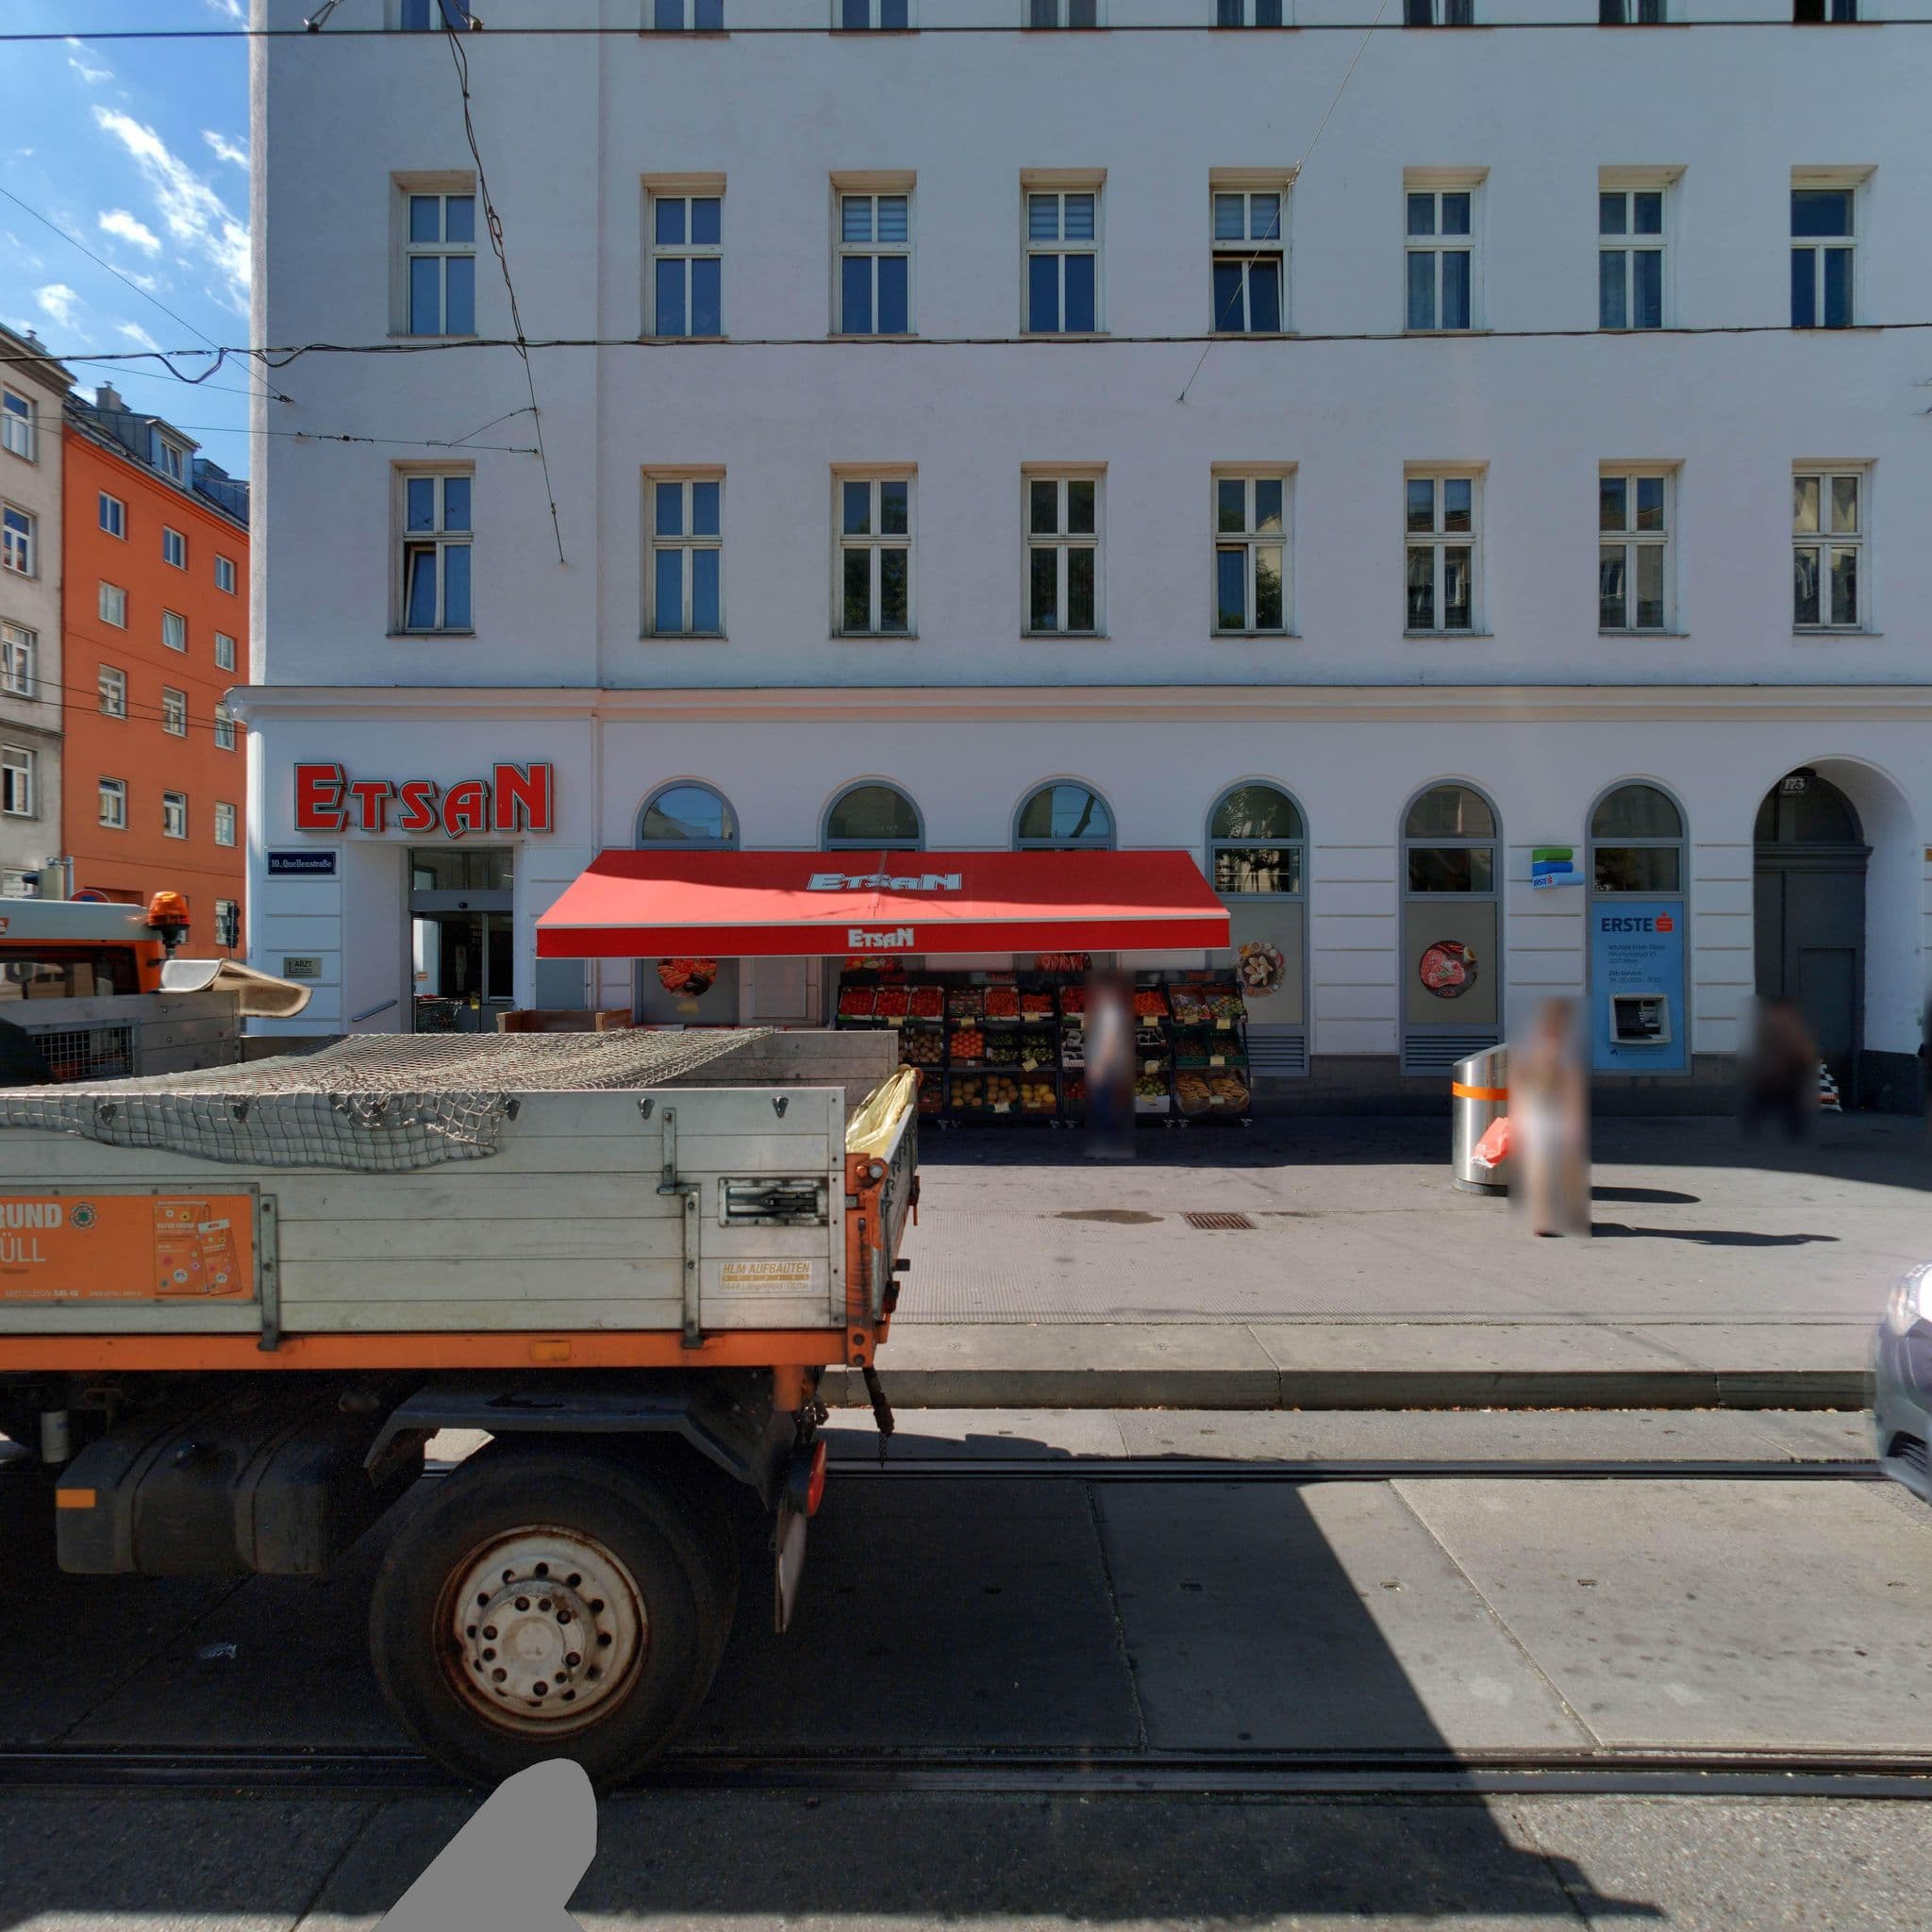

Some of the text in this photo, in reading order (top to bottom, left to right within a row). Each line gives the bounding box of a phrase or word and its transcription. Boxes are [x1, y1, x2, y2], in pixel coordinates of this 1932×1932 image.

[294, 763, 552, 839] ETSAN
[282, 858, 332, 868] Quellenstraße
[807, 874, 962, 890] ETSAN
[1533, 878, 1547, 887] ERSTE
[1601, 917, 1654, 932] ERSTE
[847, 927, 915, 948] ETSAN
[724, 1262, 810, 1274] HLM AUFBAUTEN
